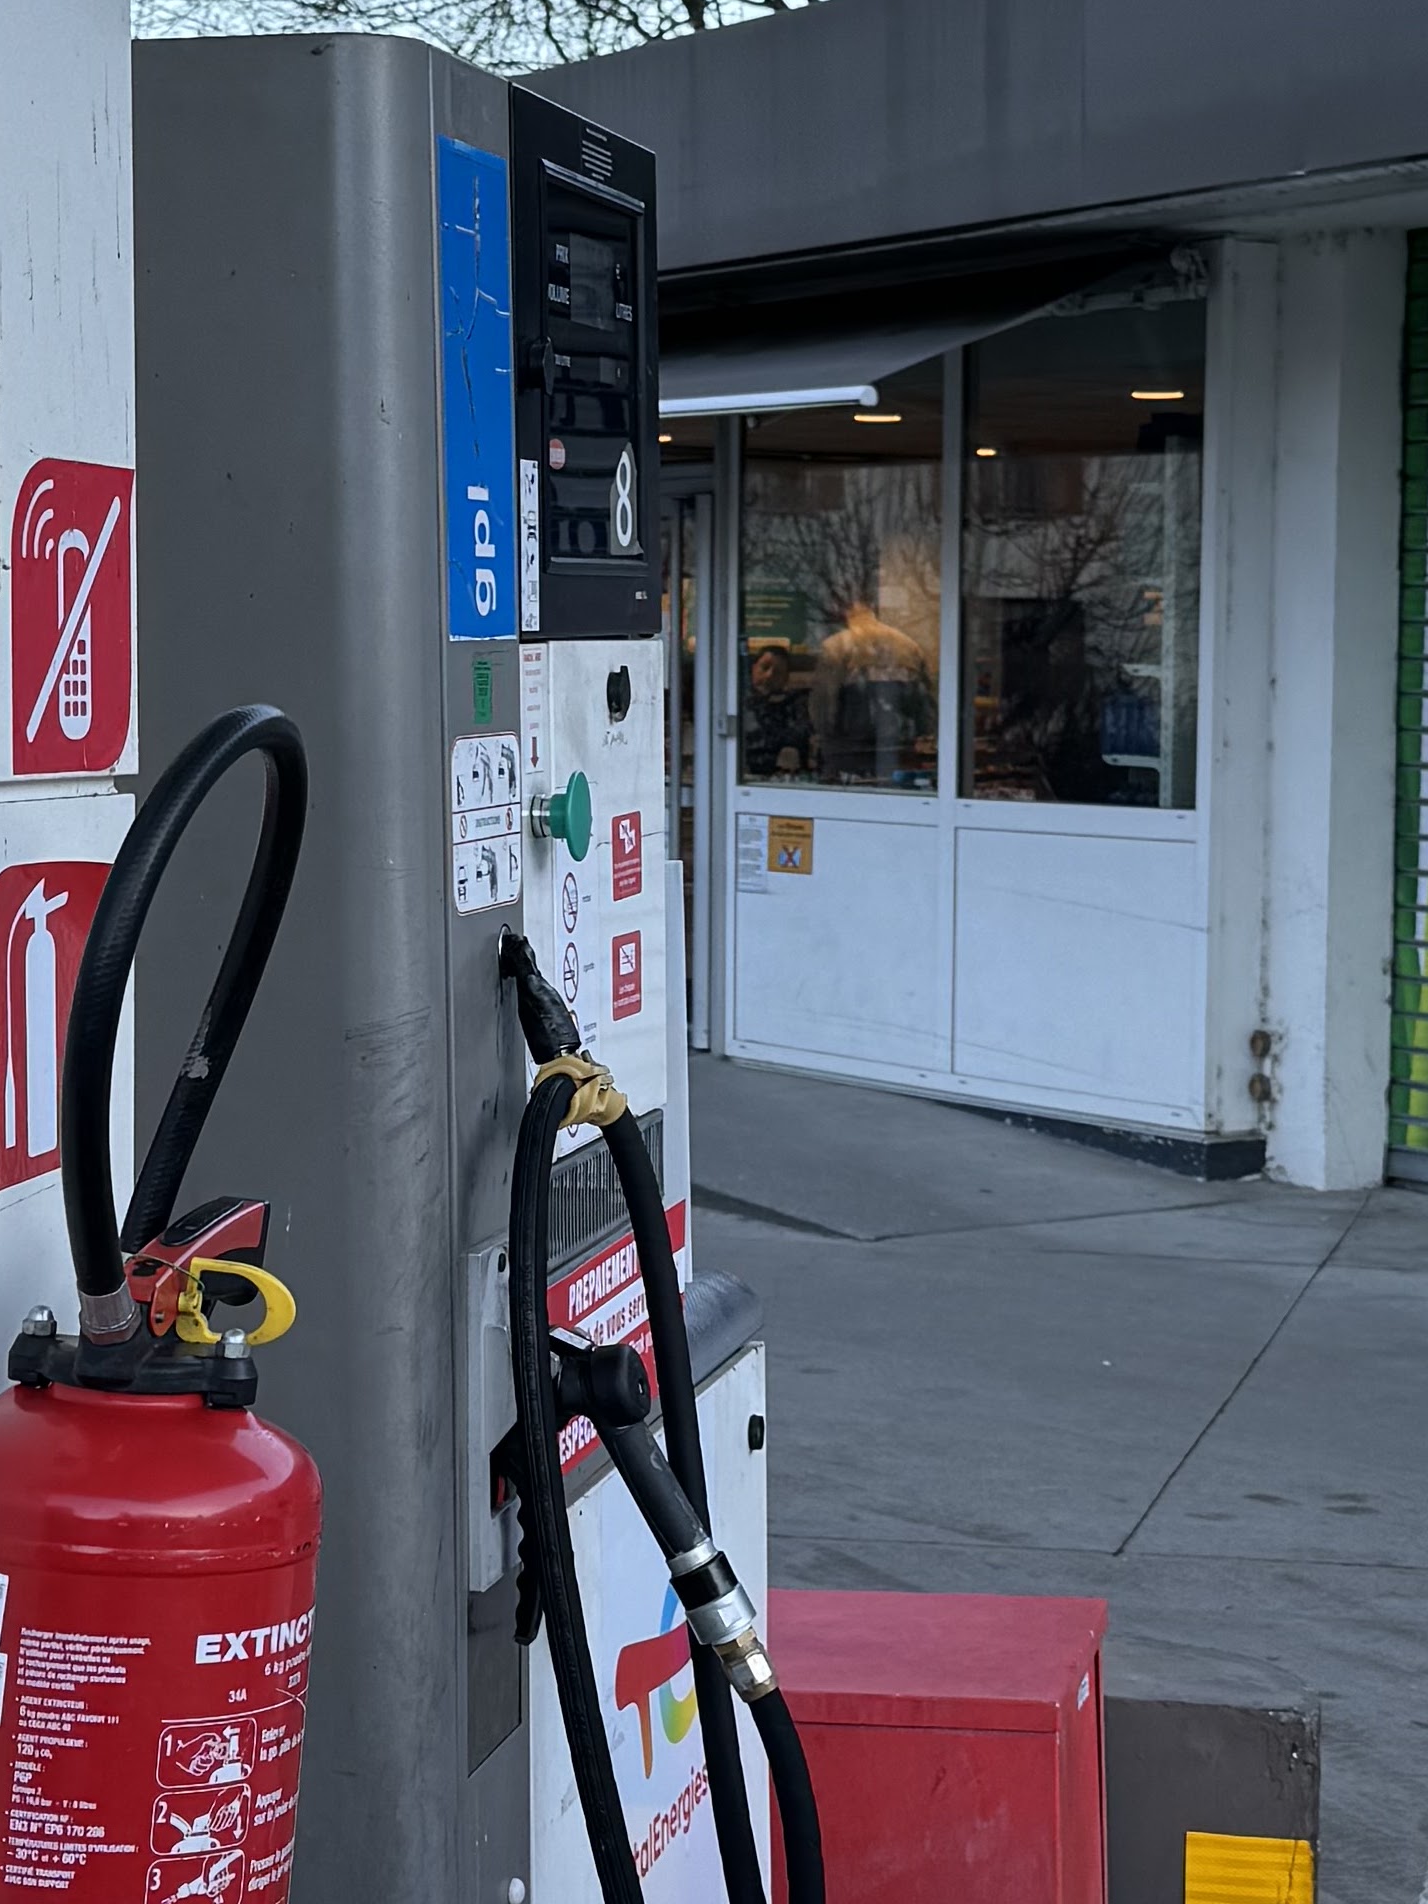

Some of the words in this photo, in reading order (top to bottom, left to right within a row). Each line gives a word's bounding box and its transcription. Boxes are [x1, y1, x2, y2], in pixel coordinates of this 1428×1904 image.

[616, 451, 633, 547] 8
[467, 485, 497, 617] gpl
[593, 1320, 604, 1345] de
[606, 1306, 626, 1340] vous
[20, 1695, 42, 1707] AGENT
[19, 1705, 26, 1718] 6
[17, 1733, 39, 1744] AGENT
[163, 1734, 173, 1757] 1
[16, 1743, 35, 1757] 120
[10, 1809, 59, 1823] CERTIFICATION
[155, 1800, 169, 1825] 2
[66, 1823, 85, 1838] 170
[149, 1868, 162, 1892] 3
